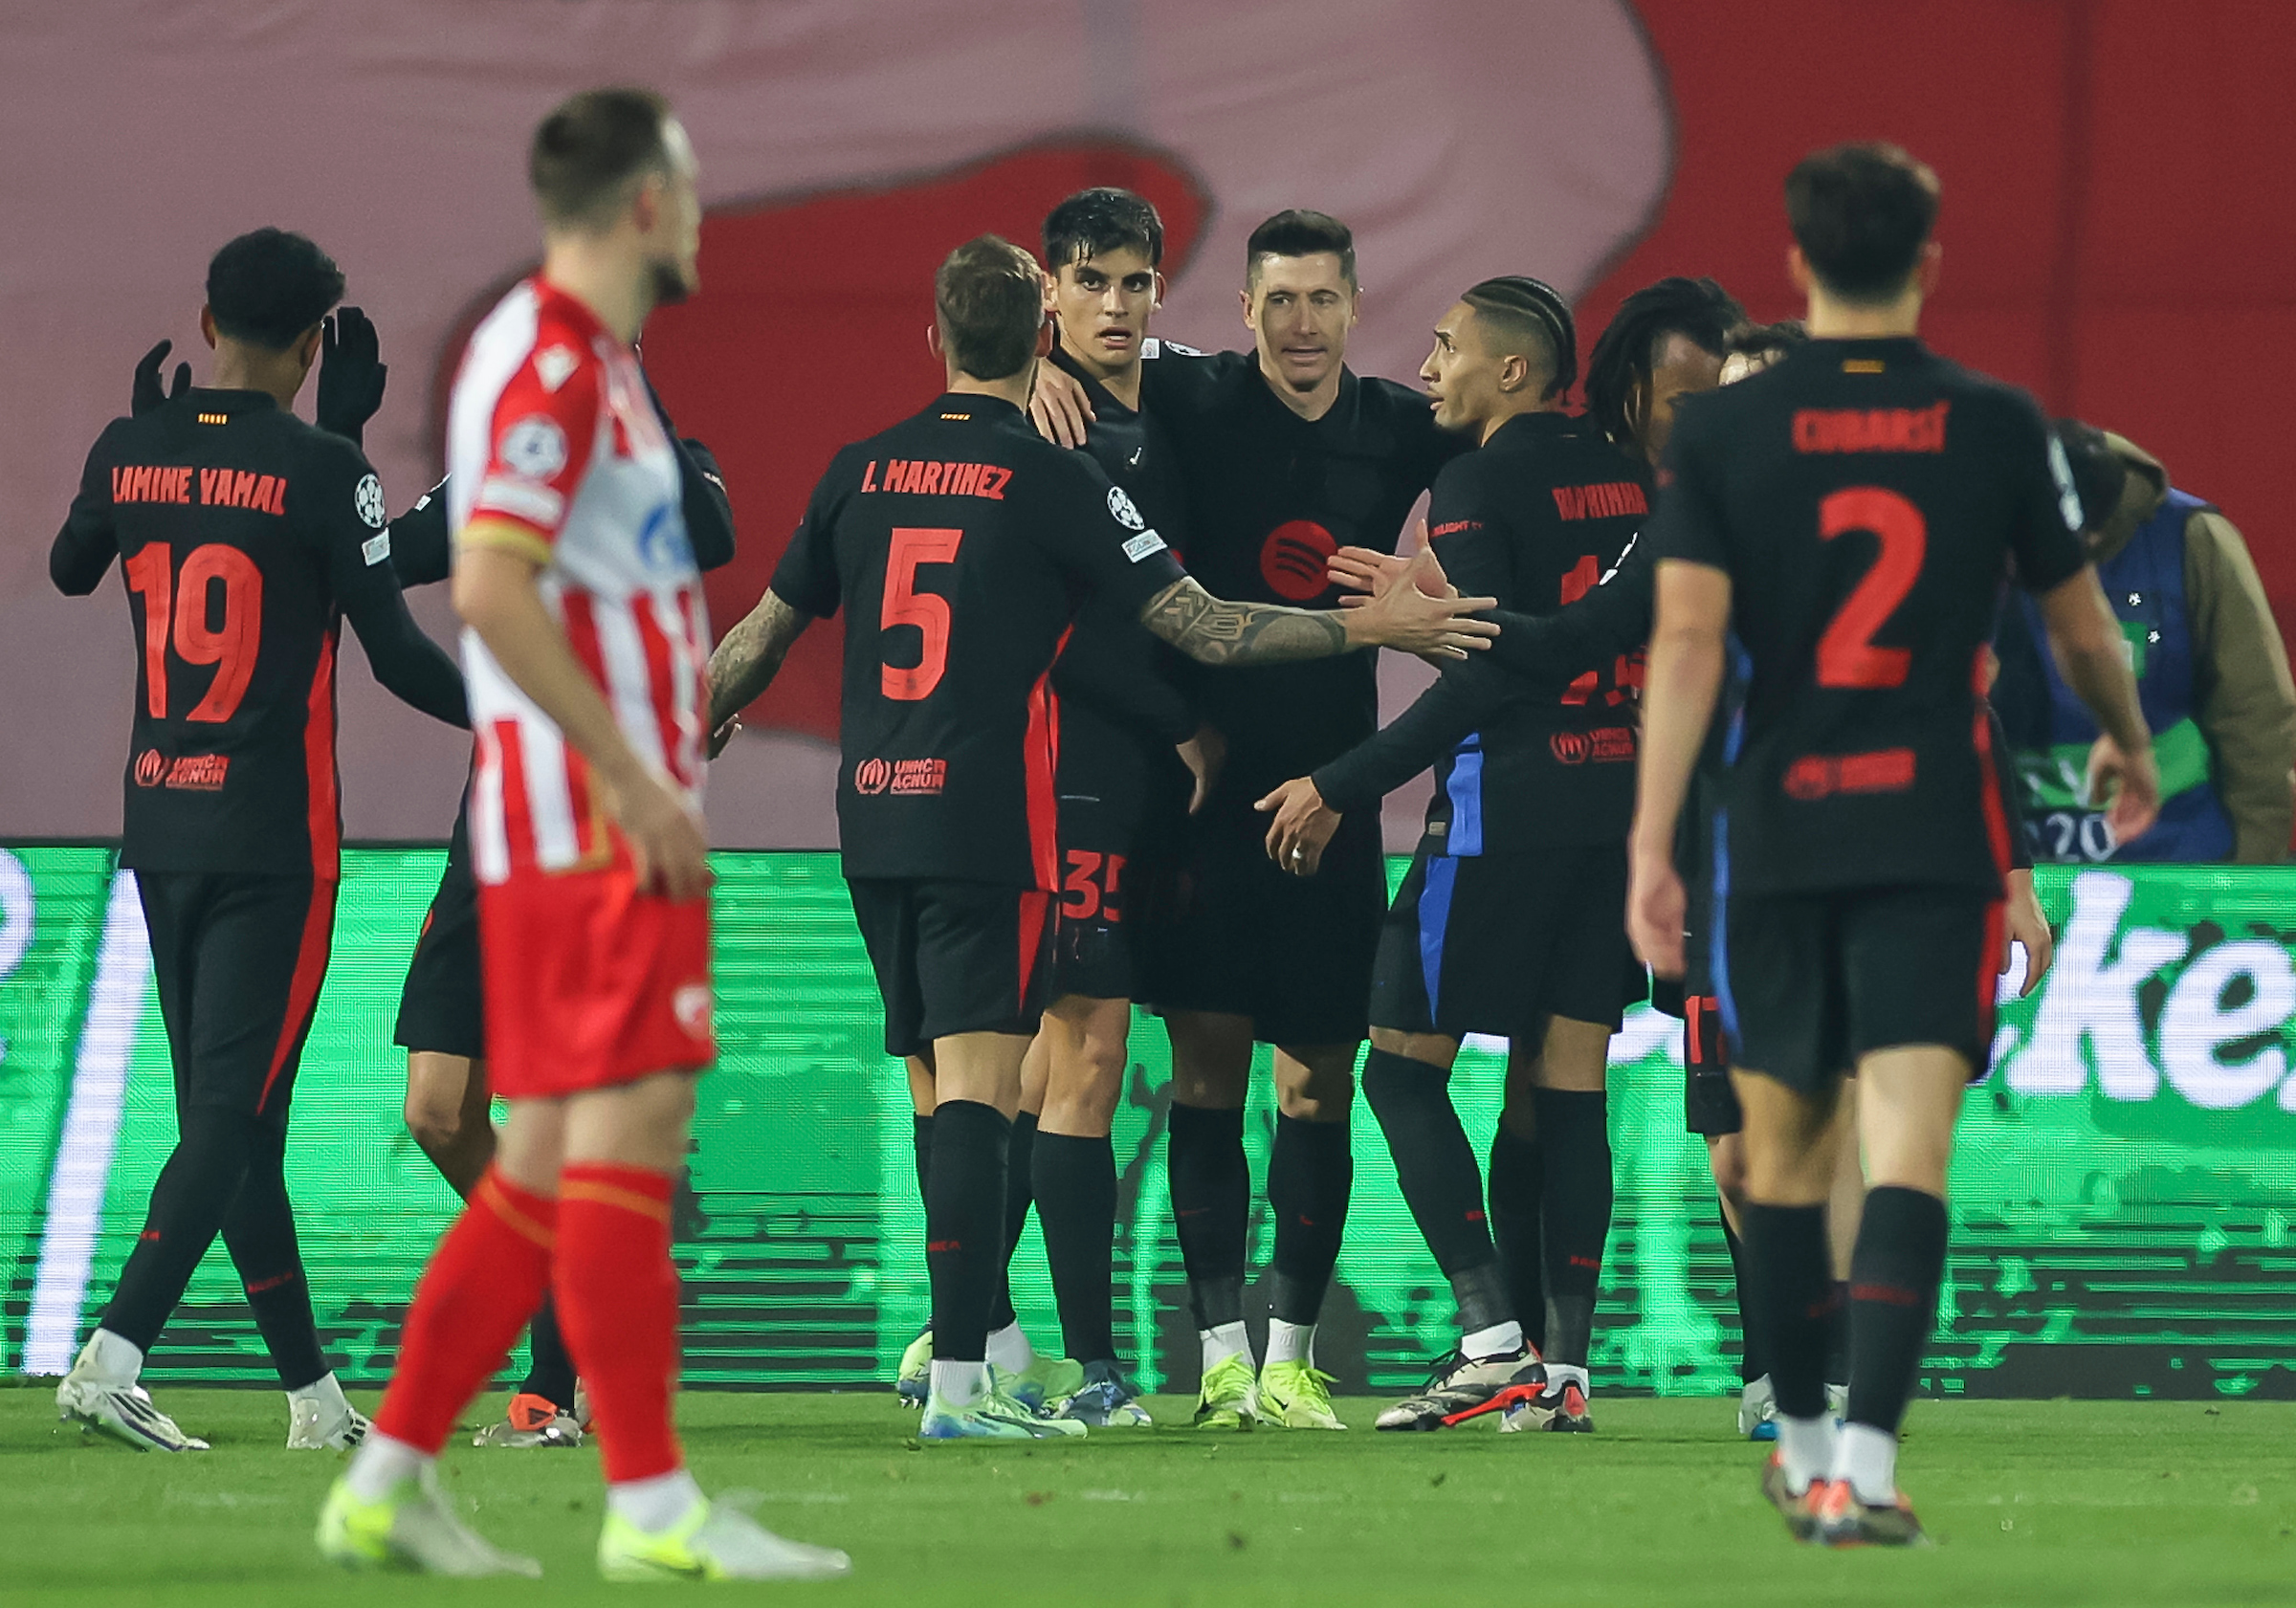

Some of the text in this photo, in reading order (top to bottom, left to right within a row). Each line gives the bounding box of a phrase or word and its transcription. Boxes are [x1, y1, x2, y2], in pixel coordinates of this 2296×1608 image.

[112, 466, 287, 516] LAMINE YAMAL
[125, 541, 263, 723] 19
[881, 527, 963, 700] 5
[1817, 485, 1928, 689] 2
[2024, 813, 2120, 862] 20
